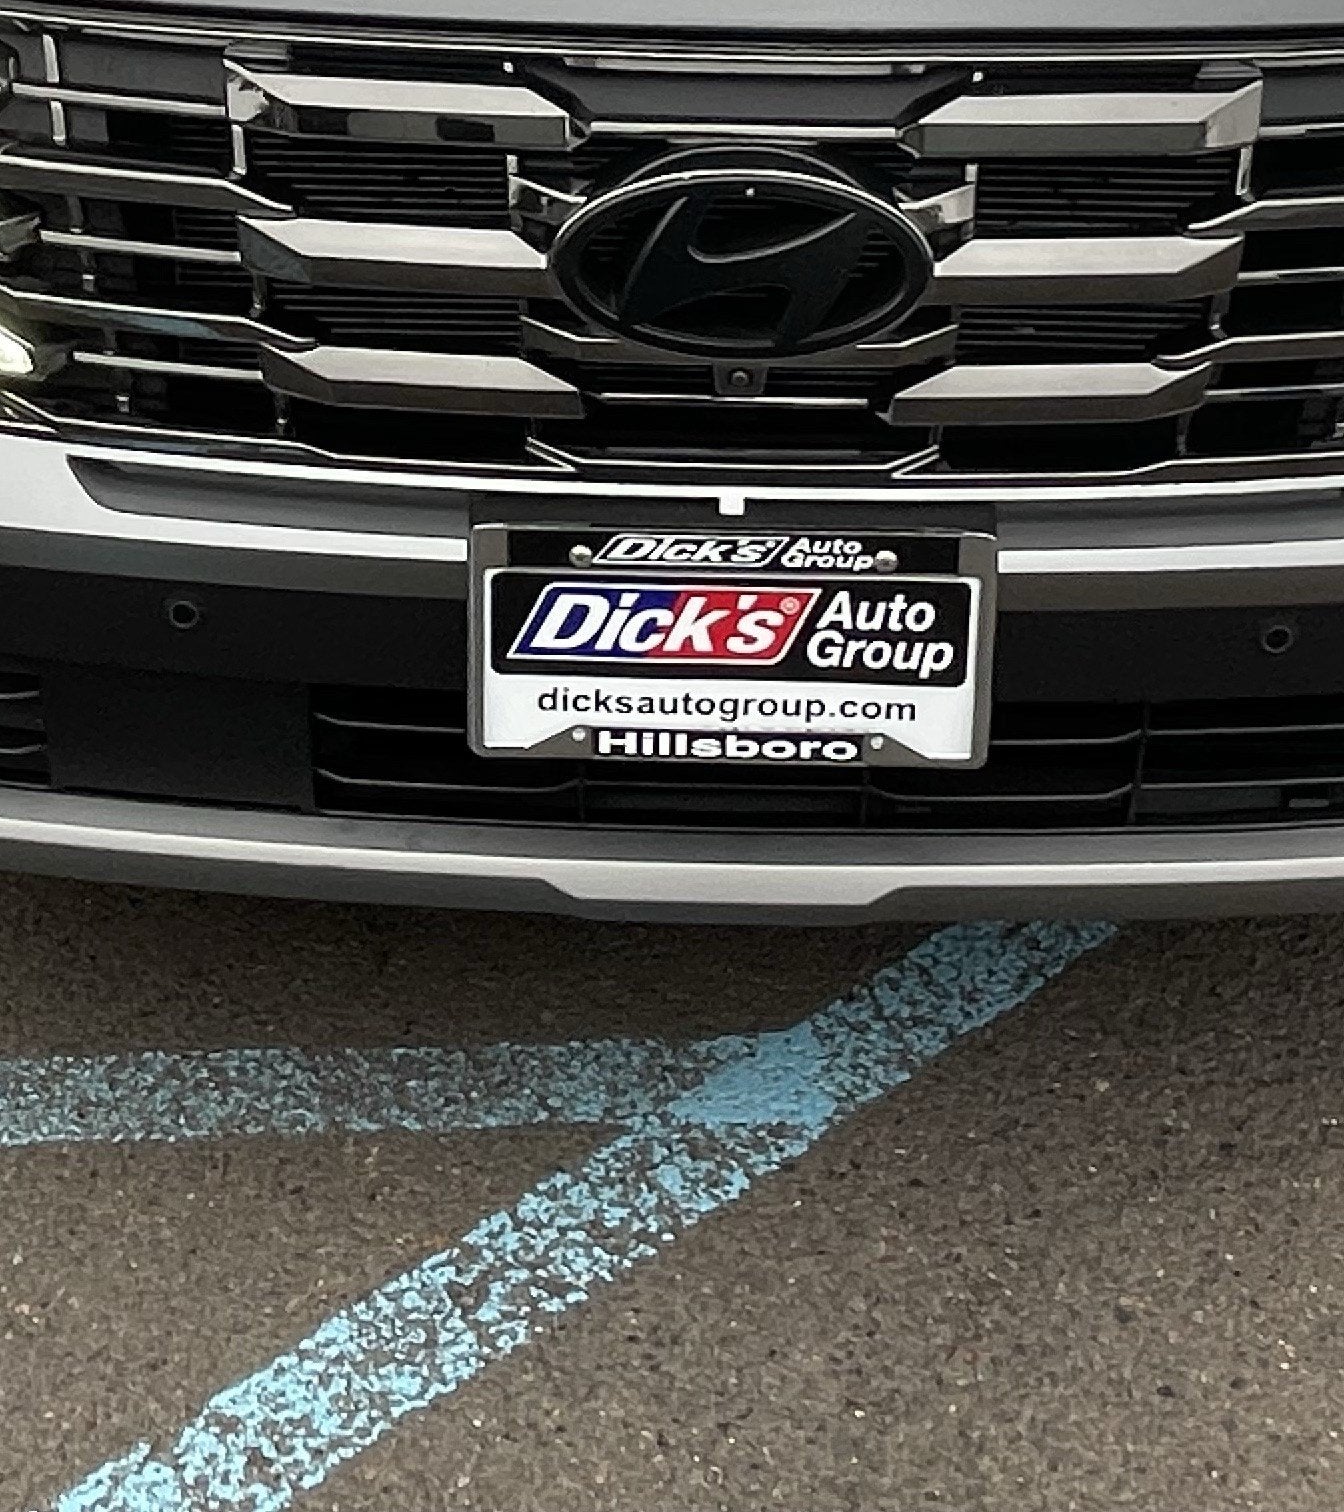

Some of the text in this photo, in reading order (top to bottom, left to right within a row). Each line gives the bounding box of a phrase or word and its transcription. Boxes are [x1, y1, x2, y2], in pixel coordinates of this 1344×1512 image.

[607, 538, 768, 562] Dick's
[789, 537, 862, 554] Auto
[780, 552, 874, 572] Group
[531, 594, 780, 652] Dick's
[816, 591, 936, 632] Auto
[807, 632, 954, 678] Group
[538, 688, 916, 722] dicksautogroup.com
[598, 731, 858, 760] Hillsboro
